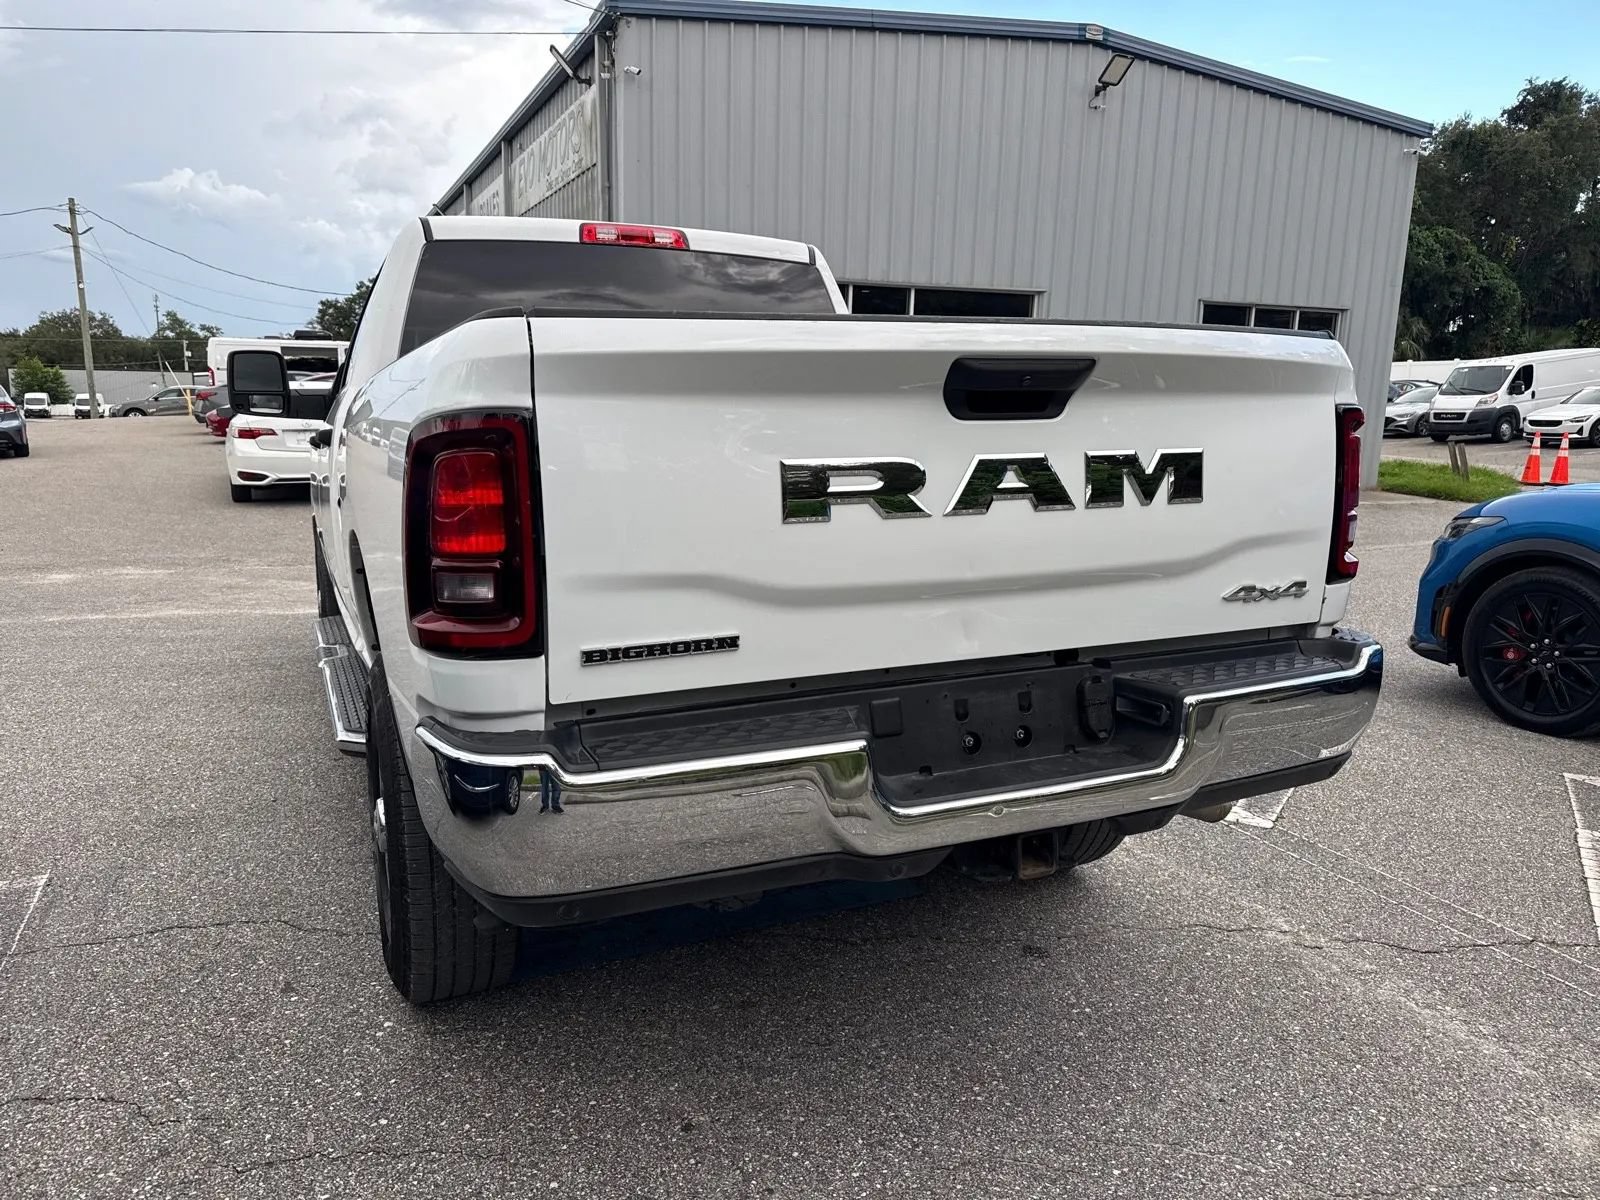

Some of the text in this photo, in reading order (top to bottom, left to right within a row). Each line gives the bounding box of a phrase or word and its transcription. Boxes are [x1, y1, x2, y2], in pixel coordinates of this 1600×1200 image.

[537, 101, 584, 184] MOTORS
[780, 447, 1204, 524] RAM
[1221, 580, 1309, 603] 4x4
[580, 633, 740, 667] BIGHORN
